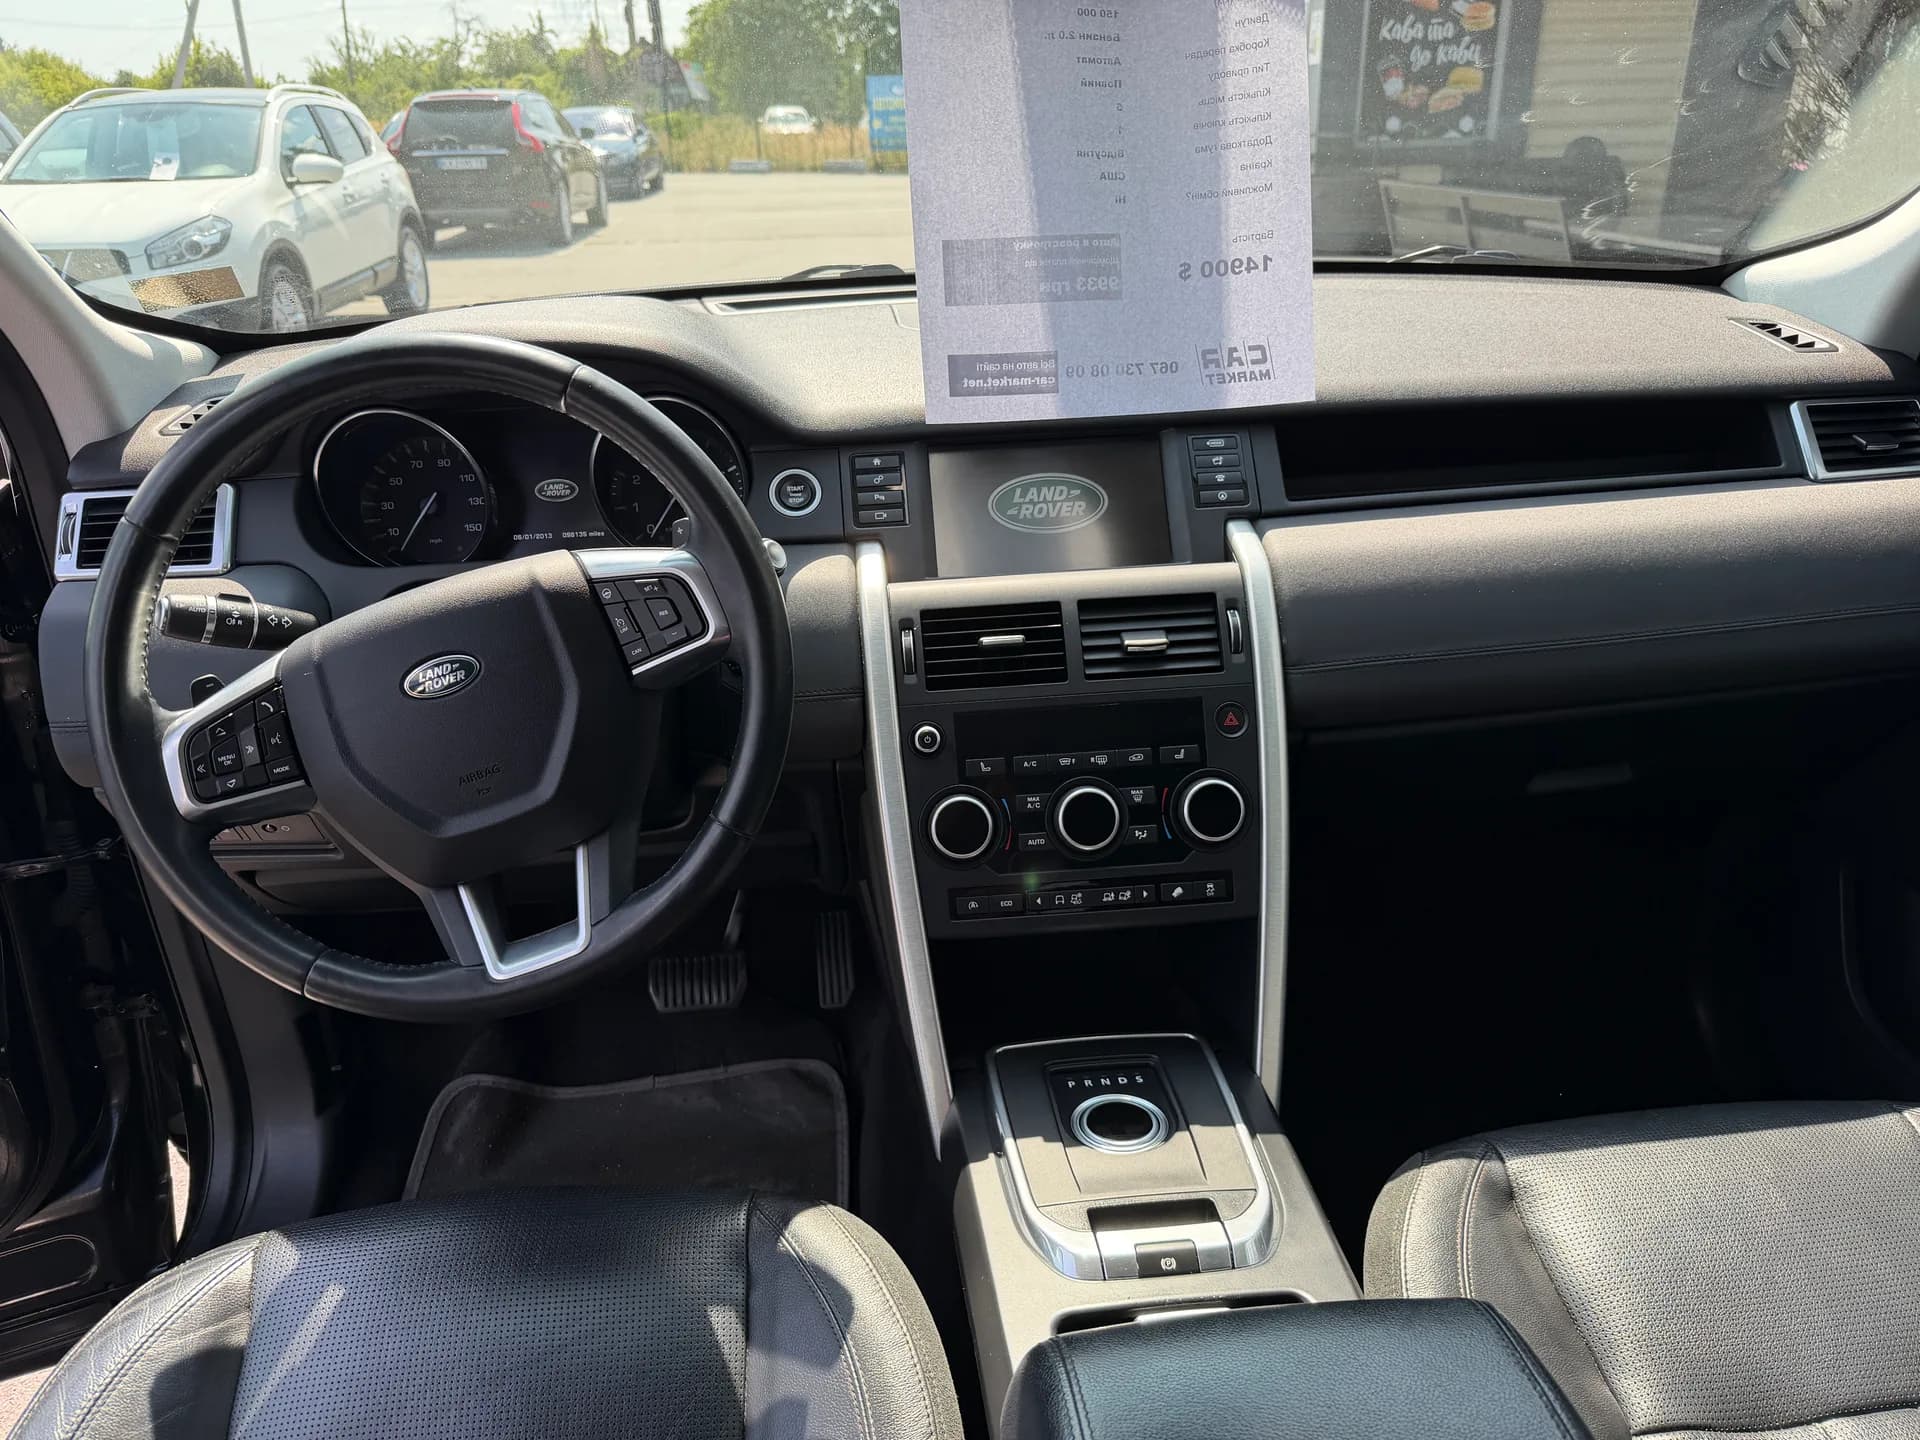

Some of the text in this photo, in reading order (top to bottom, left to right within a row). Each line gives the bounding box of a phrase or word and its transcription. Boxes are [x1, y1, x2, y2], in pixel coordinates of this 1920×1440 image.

[410, 460, 423, 469] 70
[437, 458, 451, 467] 90
[389, 477, 403, 486] 50
[459, 474, 475, 482] 110
[632, 475, 640, 485] 2
[543, 483, 564, 491] LAND
[546, 489, 571, 497] ROVER
[1013, 485, 1069, 502] LAND
[381, 501, 394, 510] 30
[633, 503, 639, 512] 1
[1019, 501, 1088, 519] ROVER
[387, 527, 399, 536] 10
[464, 523, 482, 532] 150
[631, 648, 642, 656] CAN
[418, 663, 452, 683] LAND
[424, 669, 466, 693] ROVER
[1023, 760, 1037, 768] A/C
[273, 765, 290, 774] MODE
[458, 763, 501, 787] AIRBAG
[1026, 801, 1041, 809] A/C
[1027, 838, 1045, 846] AUTO
[1067, 1081, 1076, 1089] P
[1084, 1079, 1093, 1087] R
[1100, 1078, 1111, 1086] N
[1135, 1075, 1144, 1083] S
